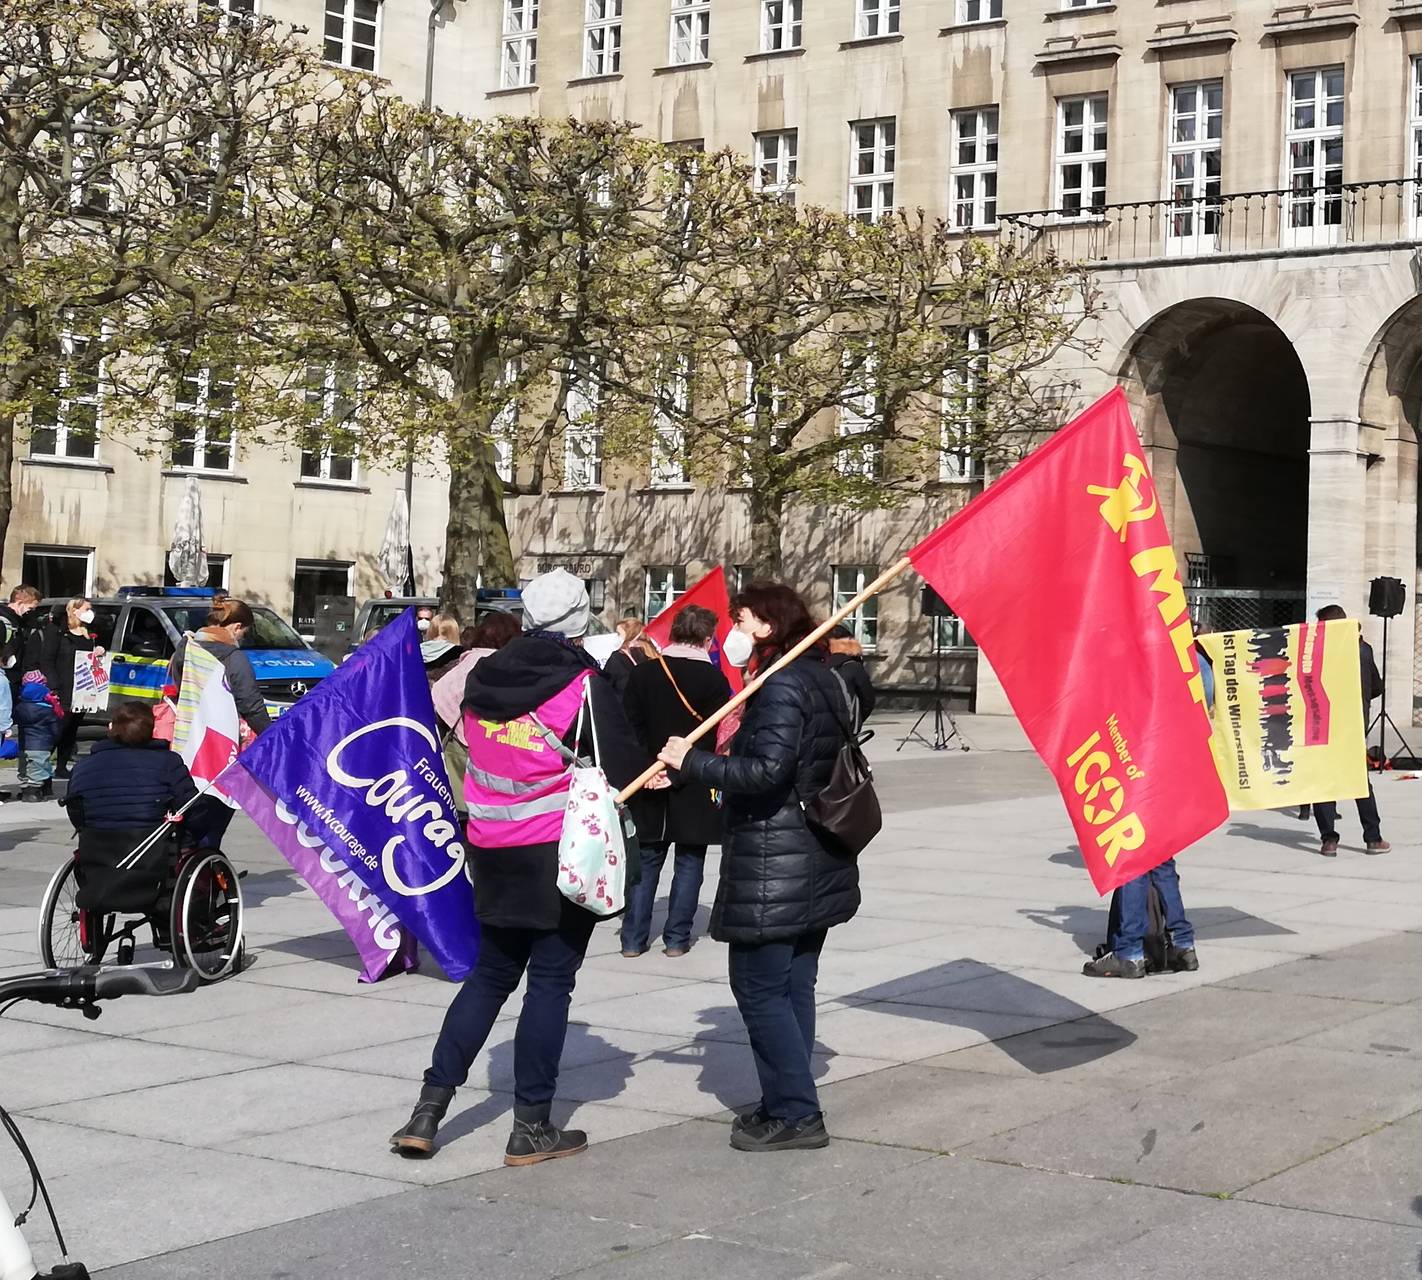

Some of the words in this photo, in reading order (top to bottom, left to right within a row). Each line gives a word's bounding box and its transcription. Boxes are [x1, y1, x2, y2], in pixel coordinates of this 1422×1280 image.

[1225, 652, 1237, 675] Tag
[1226, 678, 1240, 701] des
[1105, 712, 1132, 764] Member
[1126, 764, 1145, 780] of
[295, 785, 378, 871] www.fvcourage.de
[1066, 730, 1146, 868] ICOR
